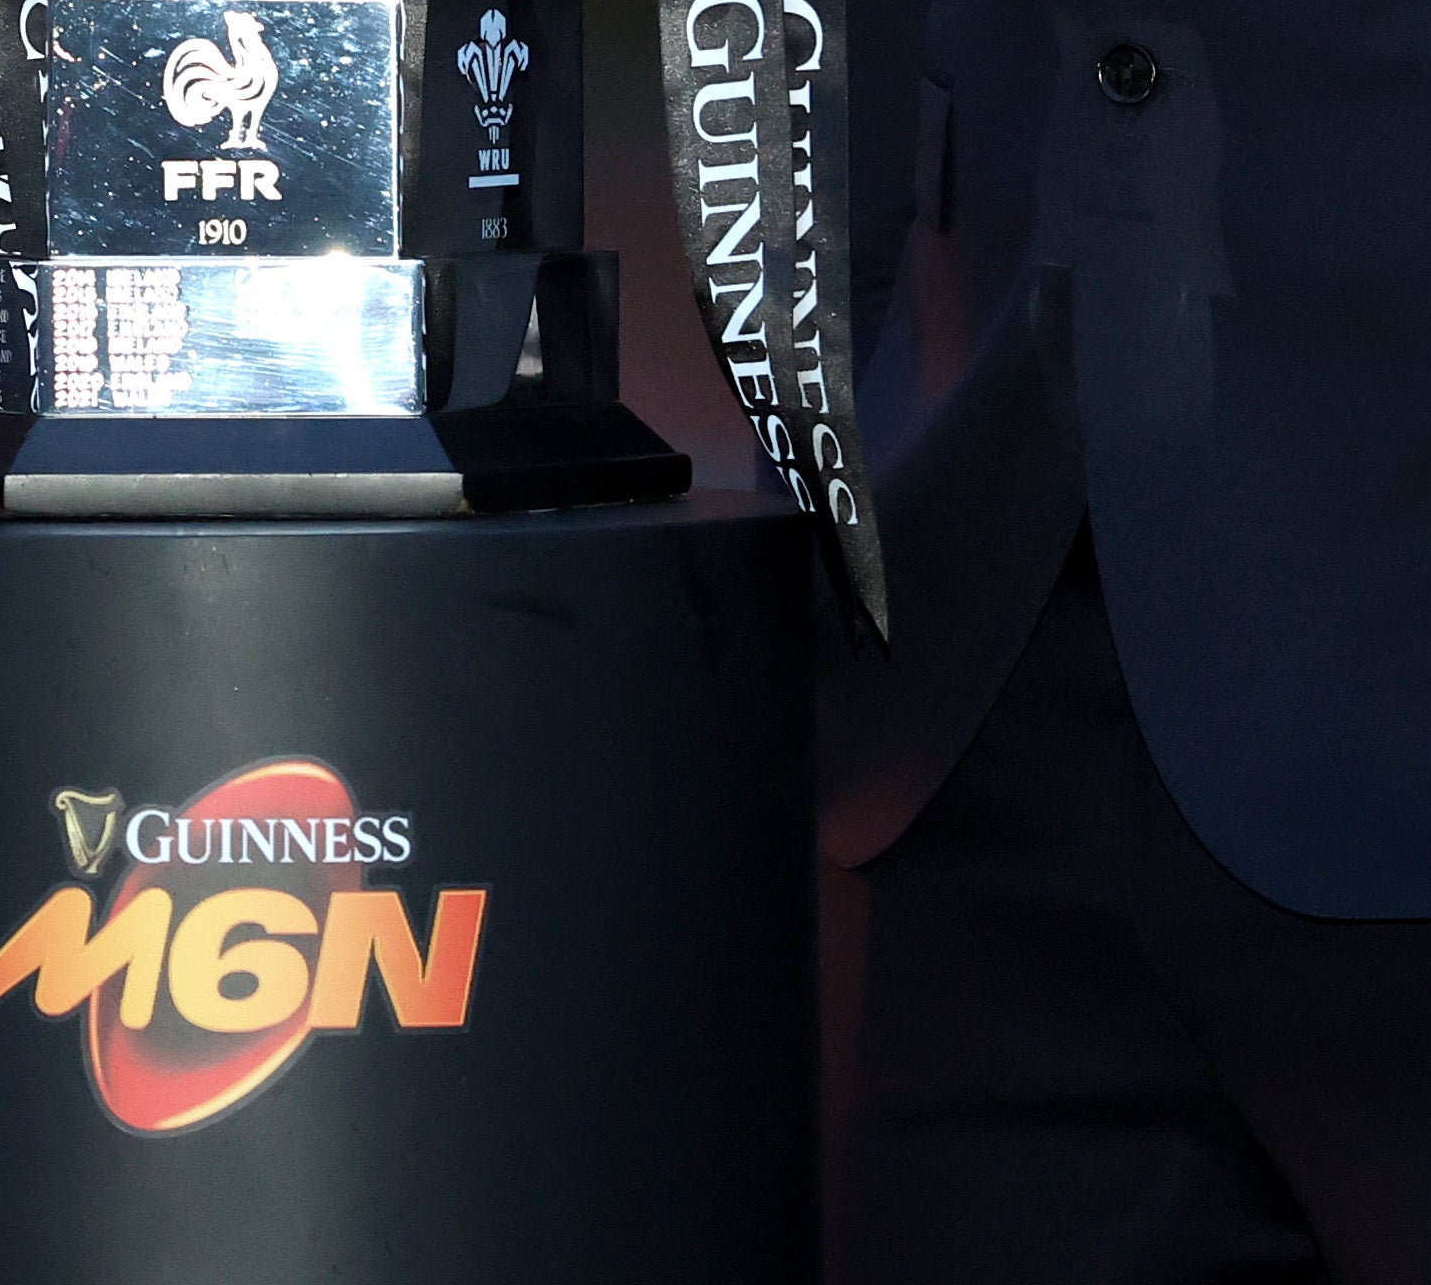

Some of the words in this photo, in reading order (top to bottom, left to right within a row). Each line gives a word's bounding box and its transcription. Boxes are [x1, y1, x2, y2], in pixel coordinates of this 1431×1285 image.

[478, 148, 510, 172] WRU
[161, 160, 283, 201] FFR
[198, 218, 247, 245] 1910
[481, 217, 508, 240] 1883
[109, 354, 170, 372] WALES
[54, 372, 104, 390] 2020
[54, 390, 99, 408] 2021
[125, 809, 411, 864] GUINNESS
